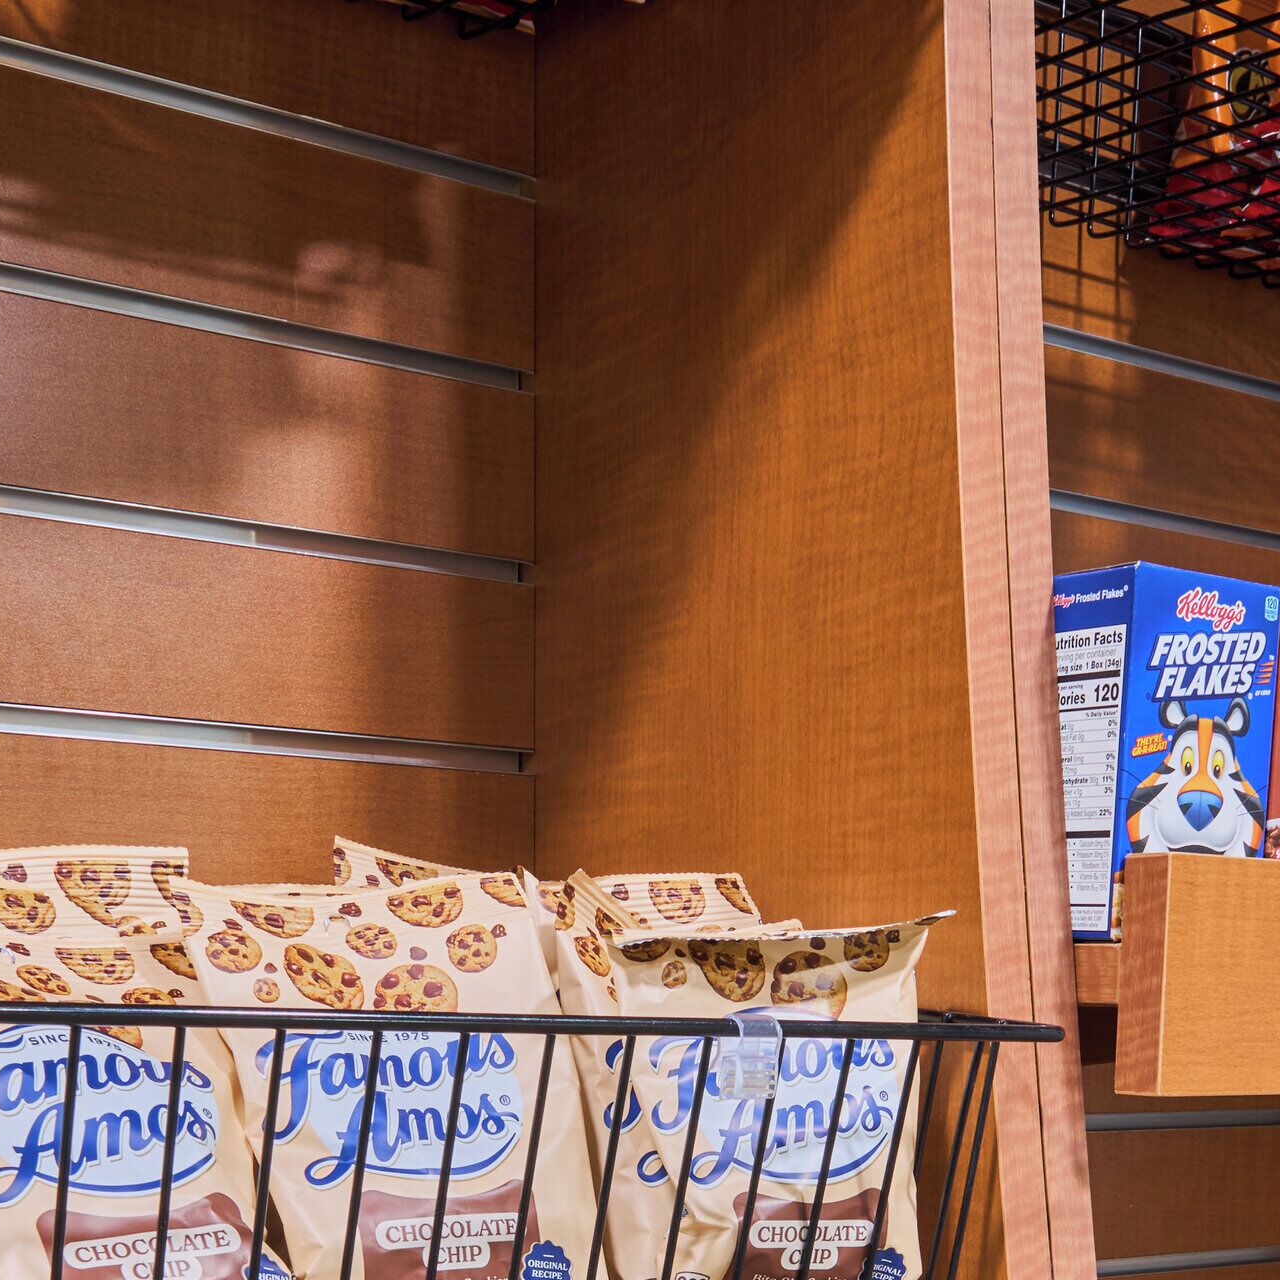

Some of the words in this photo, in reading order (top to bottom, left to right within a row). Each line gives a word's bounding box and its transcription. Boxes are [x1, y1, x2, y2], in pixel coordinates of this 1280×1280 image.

[1175, 585, 1246, 633] Kellogg's
[1094, 630, 1123, 646] Facts
[1150, 631, 1267, 667] FROSTED
[1094, 683, 1120, 702] 120
[1155, 663, 1256, 699] FLAKES
[255, 1030, 515, 1140] Famous
[305, 1091, 519, 1186] Amos
[527, 1259, 568, 1272] ORIGINAL
[531, 1269, 563, 1280] RECIPE
